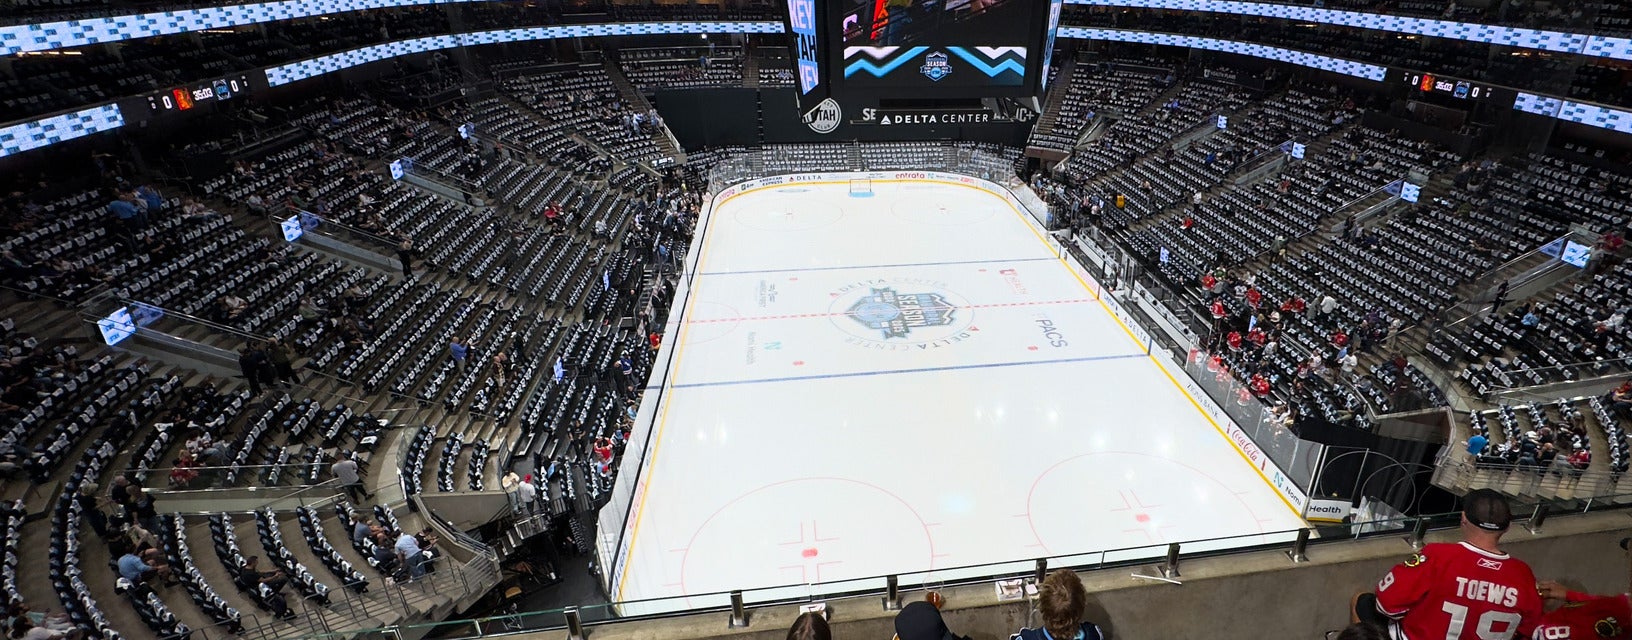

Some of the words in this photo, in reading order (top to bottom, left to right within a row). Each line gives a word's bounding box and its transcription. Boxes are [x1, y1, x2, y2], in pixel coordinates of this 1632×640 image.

[787, 0, 813, 29] KEY
[162, 96, 172, 109] 0
[193, 88, 213, 101] 35:03
[230, 80, 239, 92] 0
[819, 109, 836, 121] TAH
[894, 114, 937, 124] DELTA
[942, 113, 989, 123] CENTER
[839, 277, 886, 292] DELTA
[1128, 320, 1147, 343] DELTA
[1285, 486, 1302, 506] Nomi
[1309, 505, 1342, 514] Health
[1456, 576, 1519, 608] TOEWS
